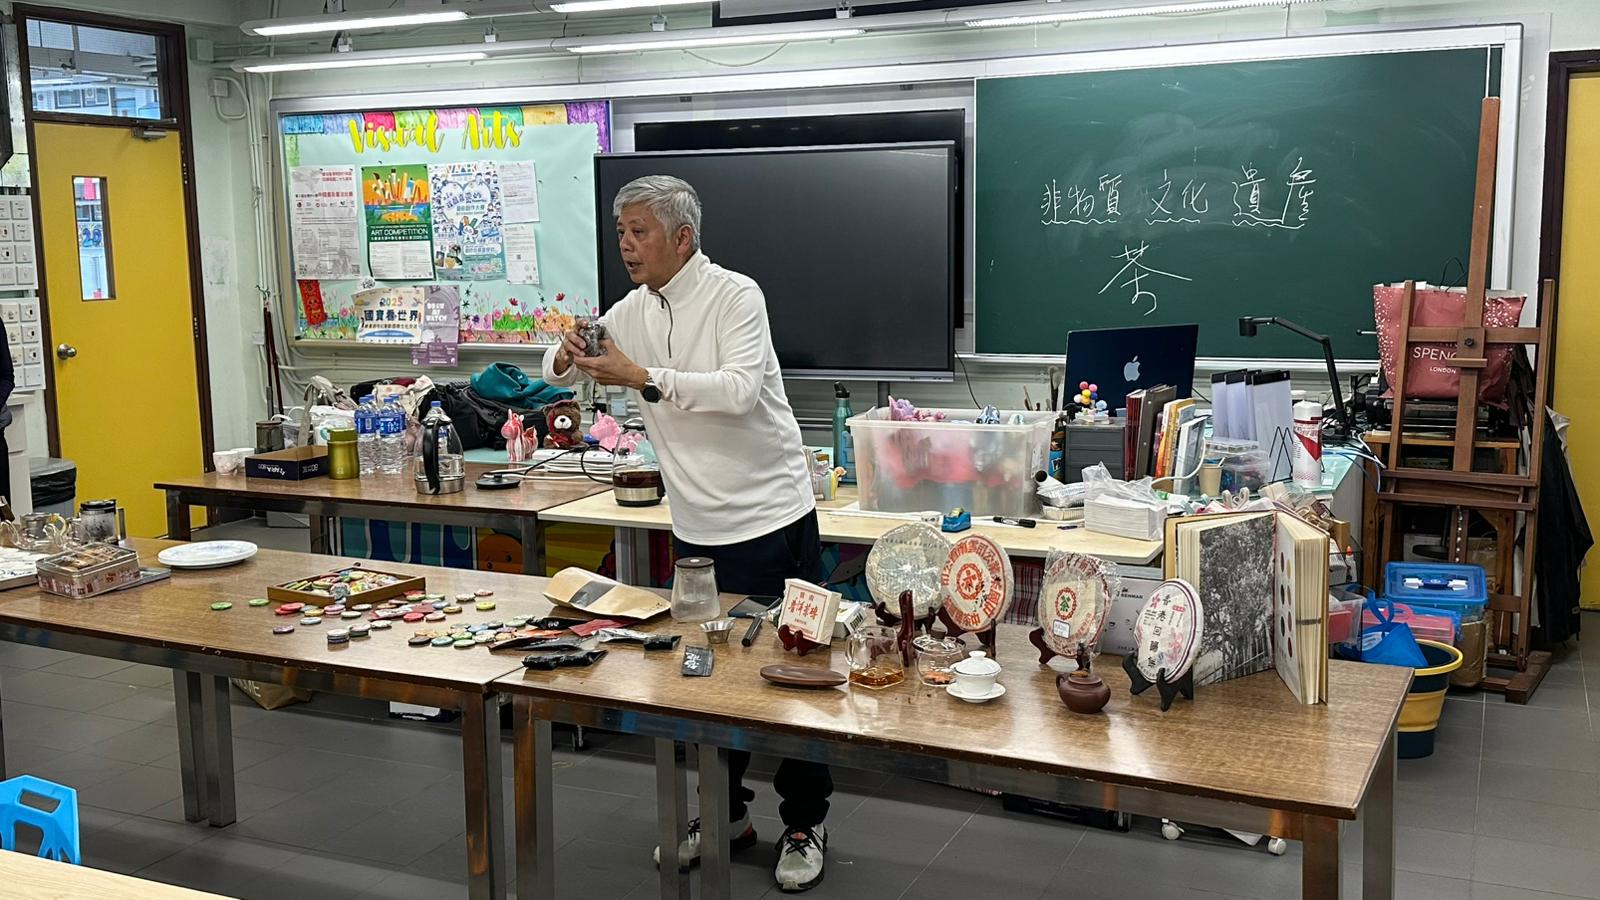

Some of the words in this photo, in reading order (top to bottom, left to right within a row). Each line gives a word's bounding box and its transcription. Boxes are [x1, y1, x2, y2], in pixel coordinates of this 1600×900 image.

[348, 113, 445, 153] Visual
[463, 111, 522, 150] Arts
[1041, 174, 1122, 221] 非物質
[1151, 168, 1208, 215] 文化
[384, 227, 429, 236] COMPETITION
[1098, 240, 1192, 316] 茶
[1429, 366, 1456, 374] LONDON
